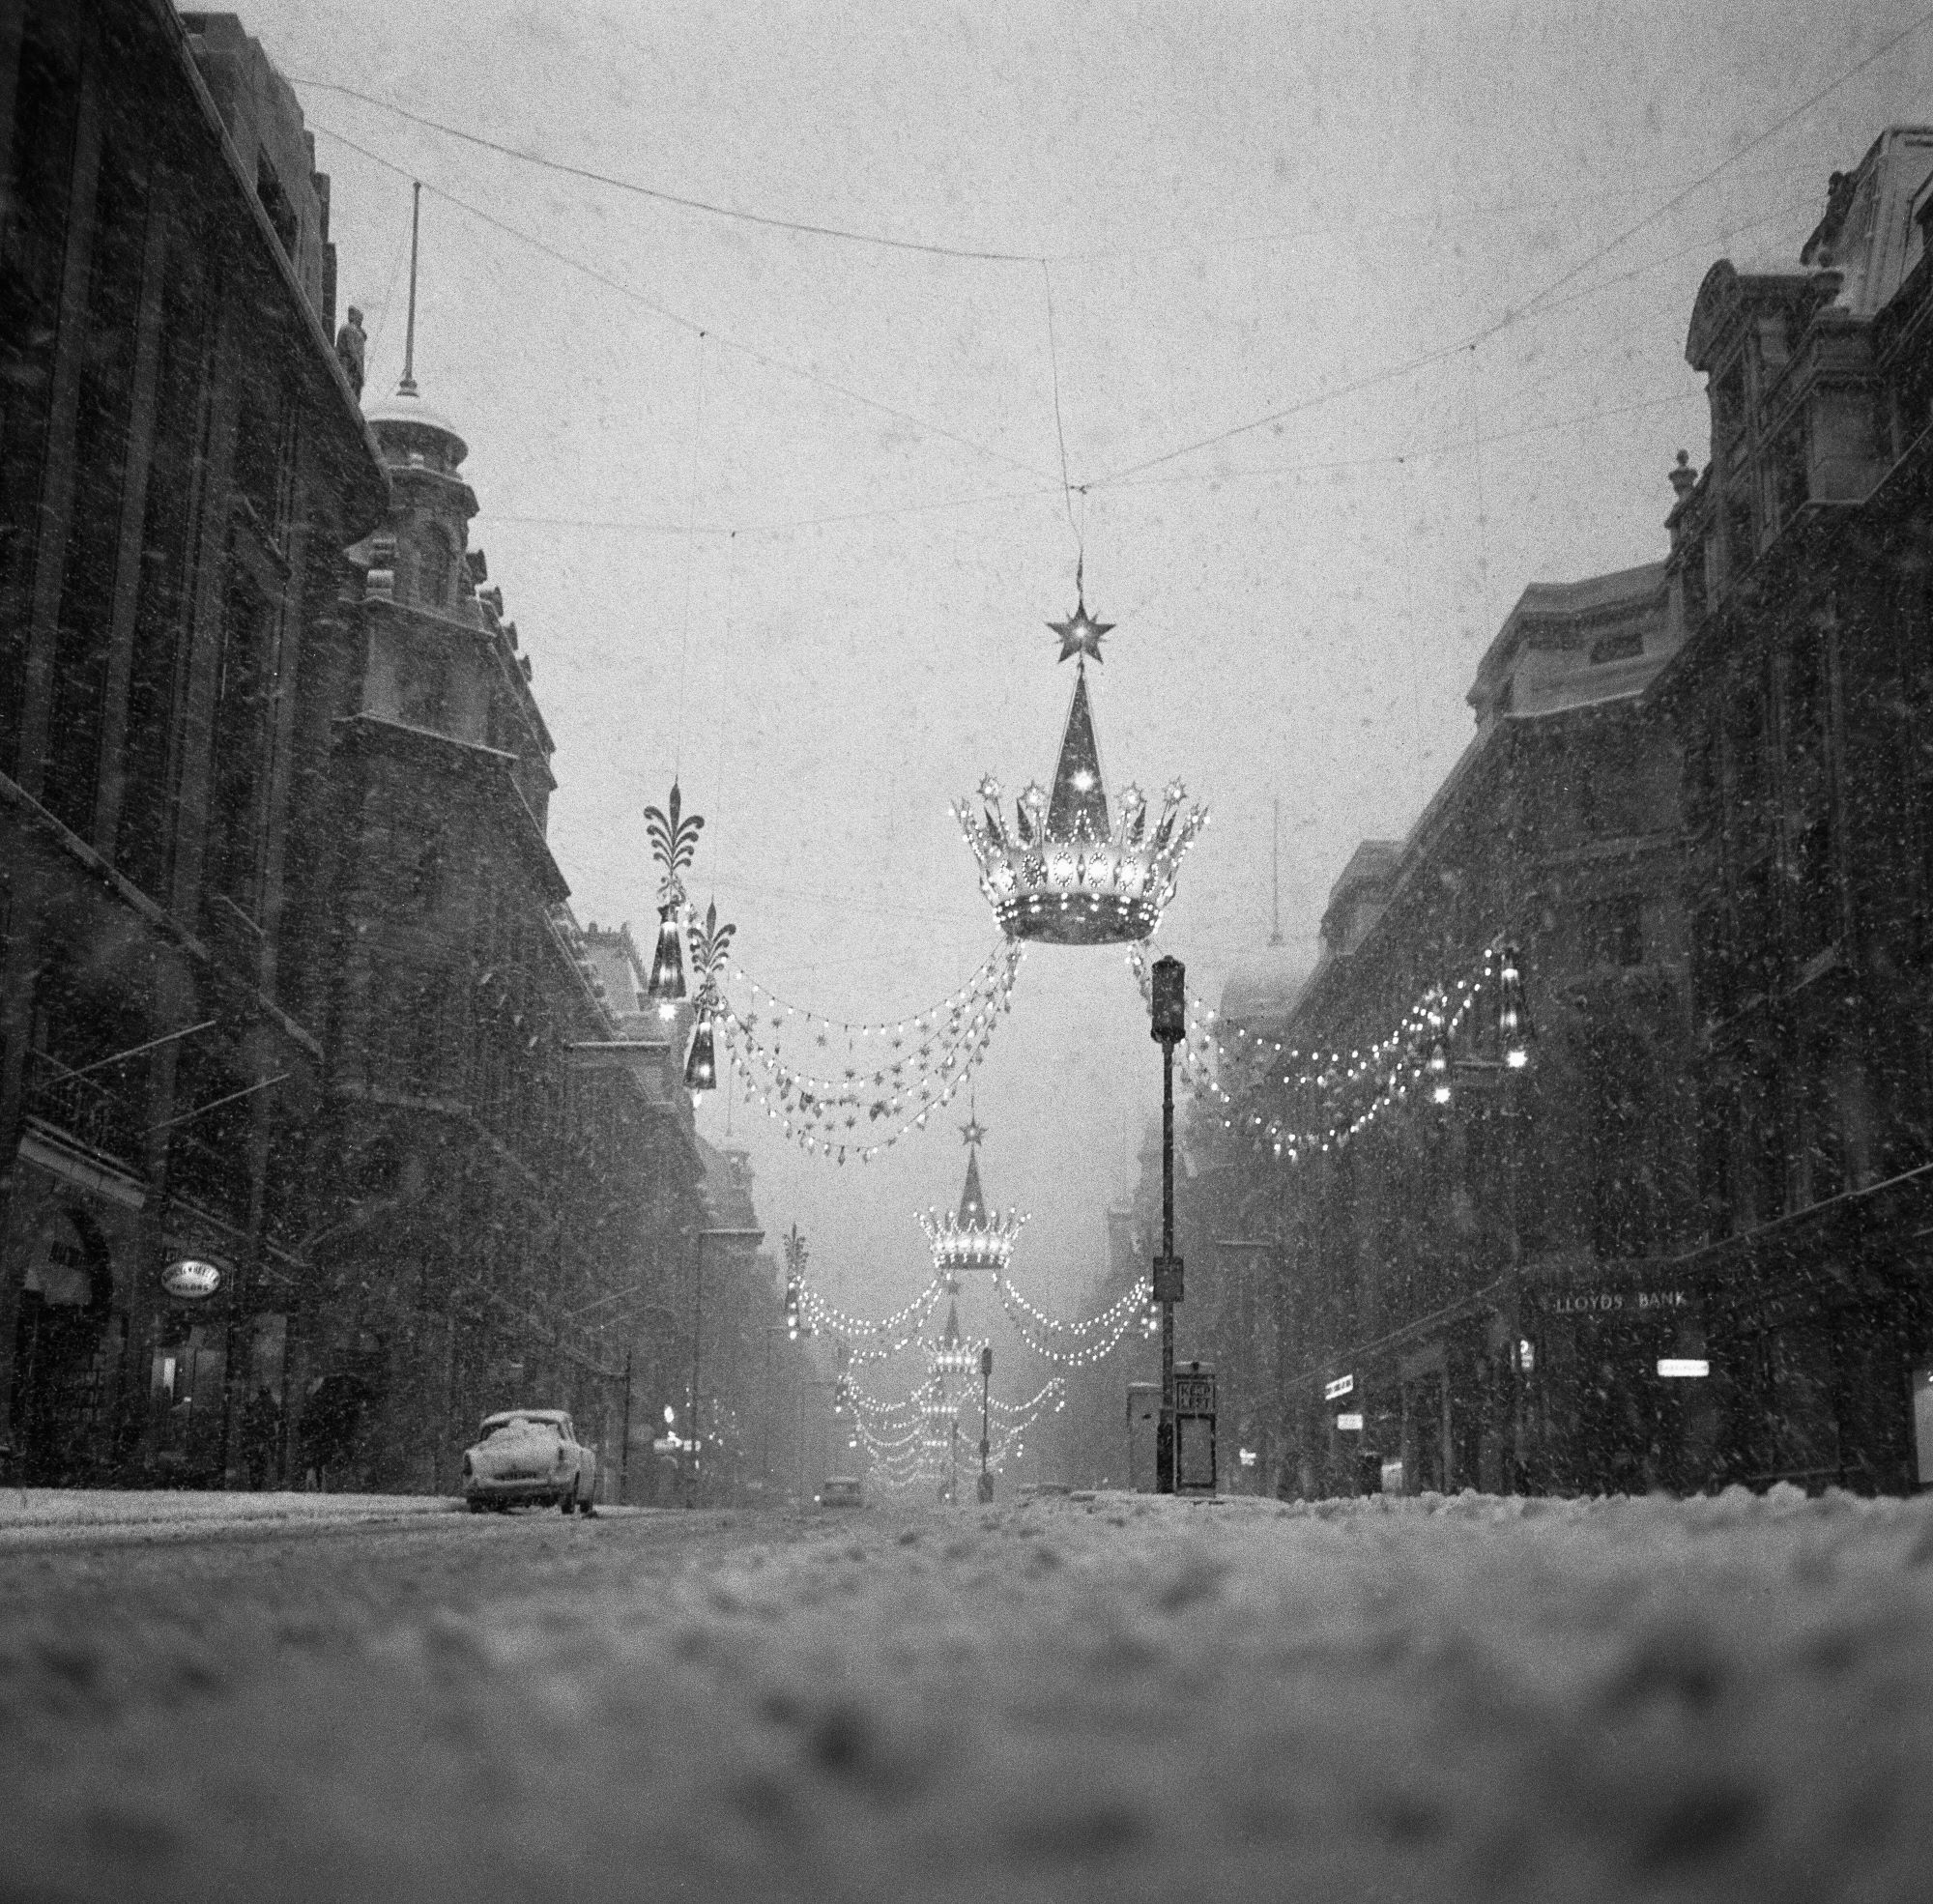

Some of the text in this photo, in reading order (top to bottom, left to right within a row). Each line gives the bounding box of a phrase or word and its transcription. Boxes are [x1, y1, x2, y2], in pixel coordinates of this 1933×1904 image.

[1556, 1290, 1687, 1313] LLOYDS BANK
[1180, 1384, 1211, 1397] KEEP
[1180, 1398, 1210, 1410] LEFT
